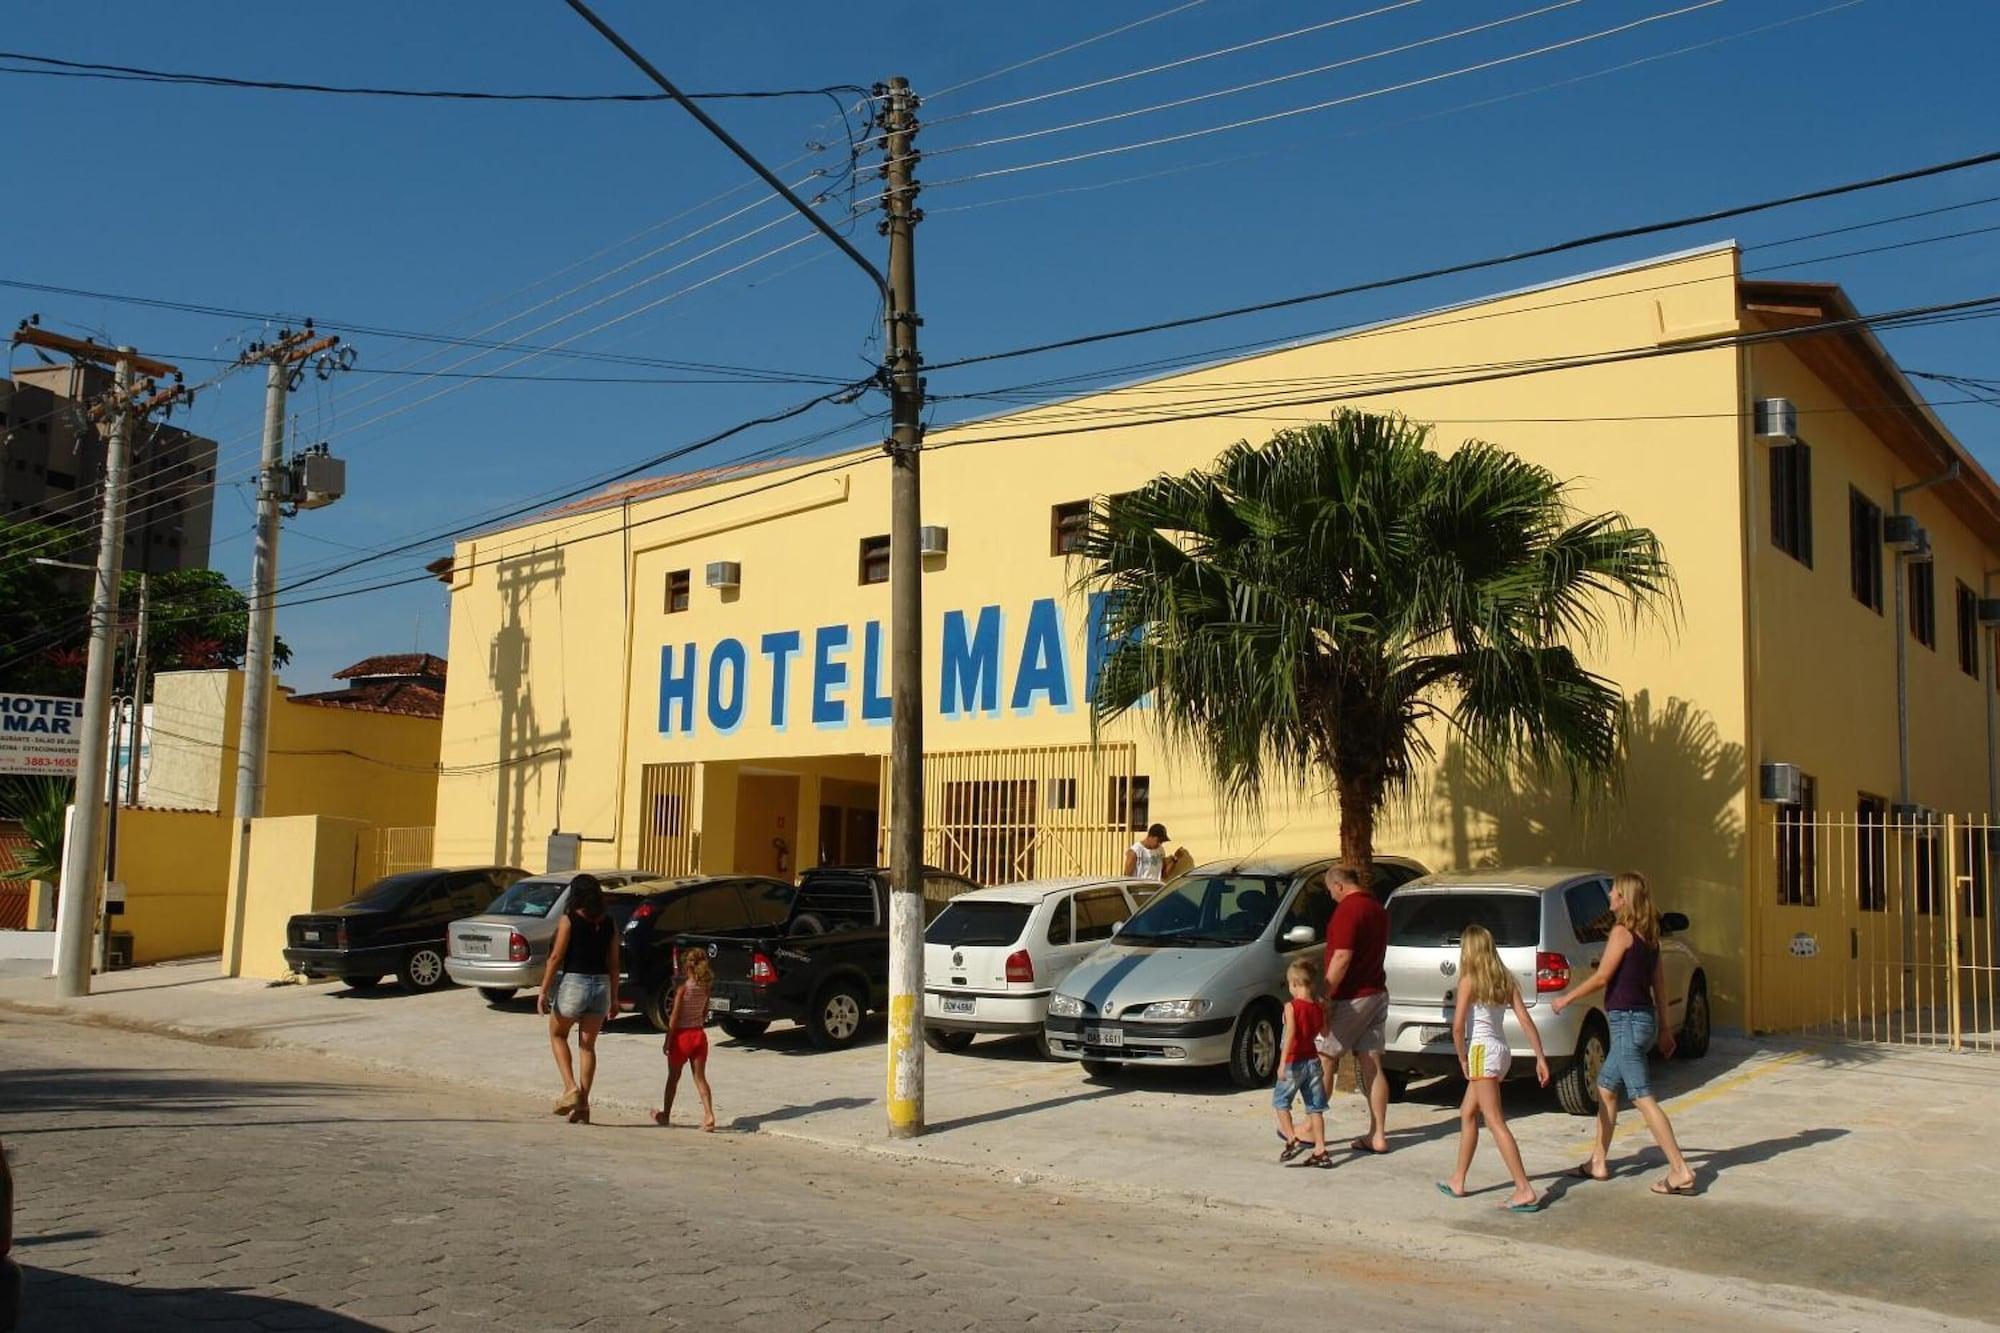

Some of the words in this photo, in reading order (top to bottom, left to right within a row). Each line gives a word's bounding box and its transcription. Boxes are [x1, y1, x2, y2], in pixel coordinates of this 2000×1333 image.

[658, 621, 892, 736] HOTEL
[0, 696, 83, 718] HOTEL
[3, 714, 71, 734] MAR
